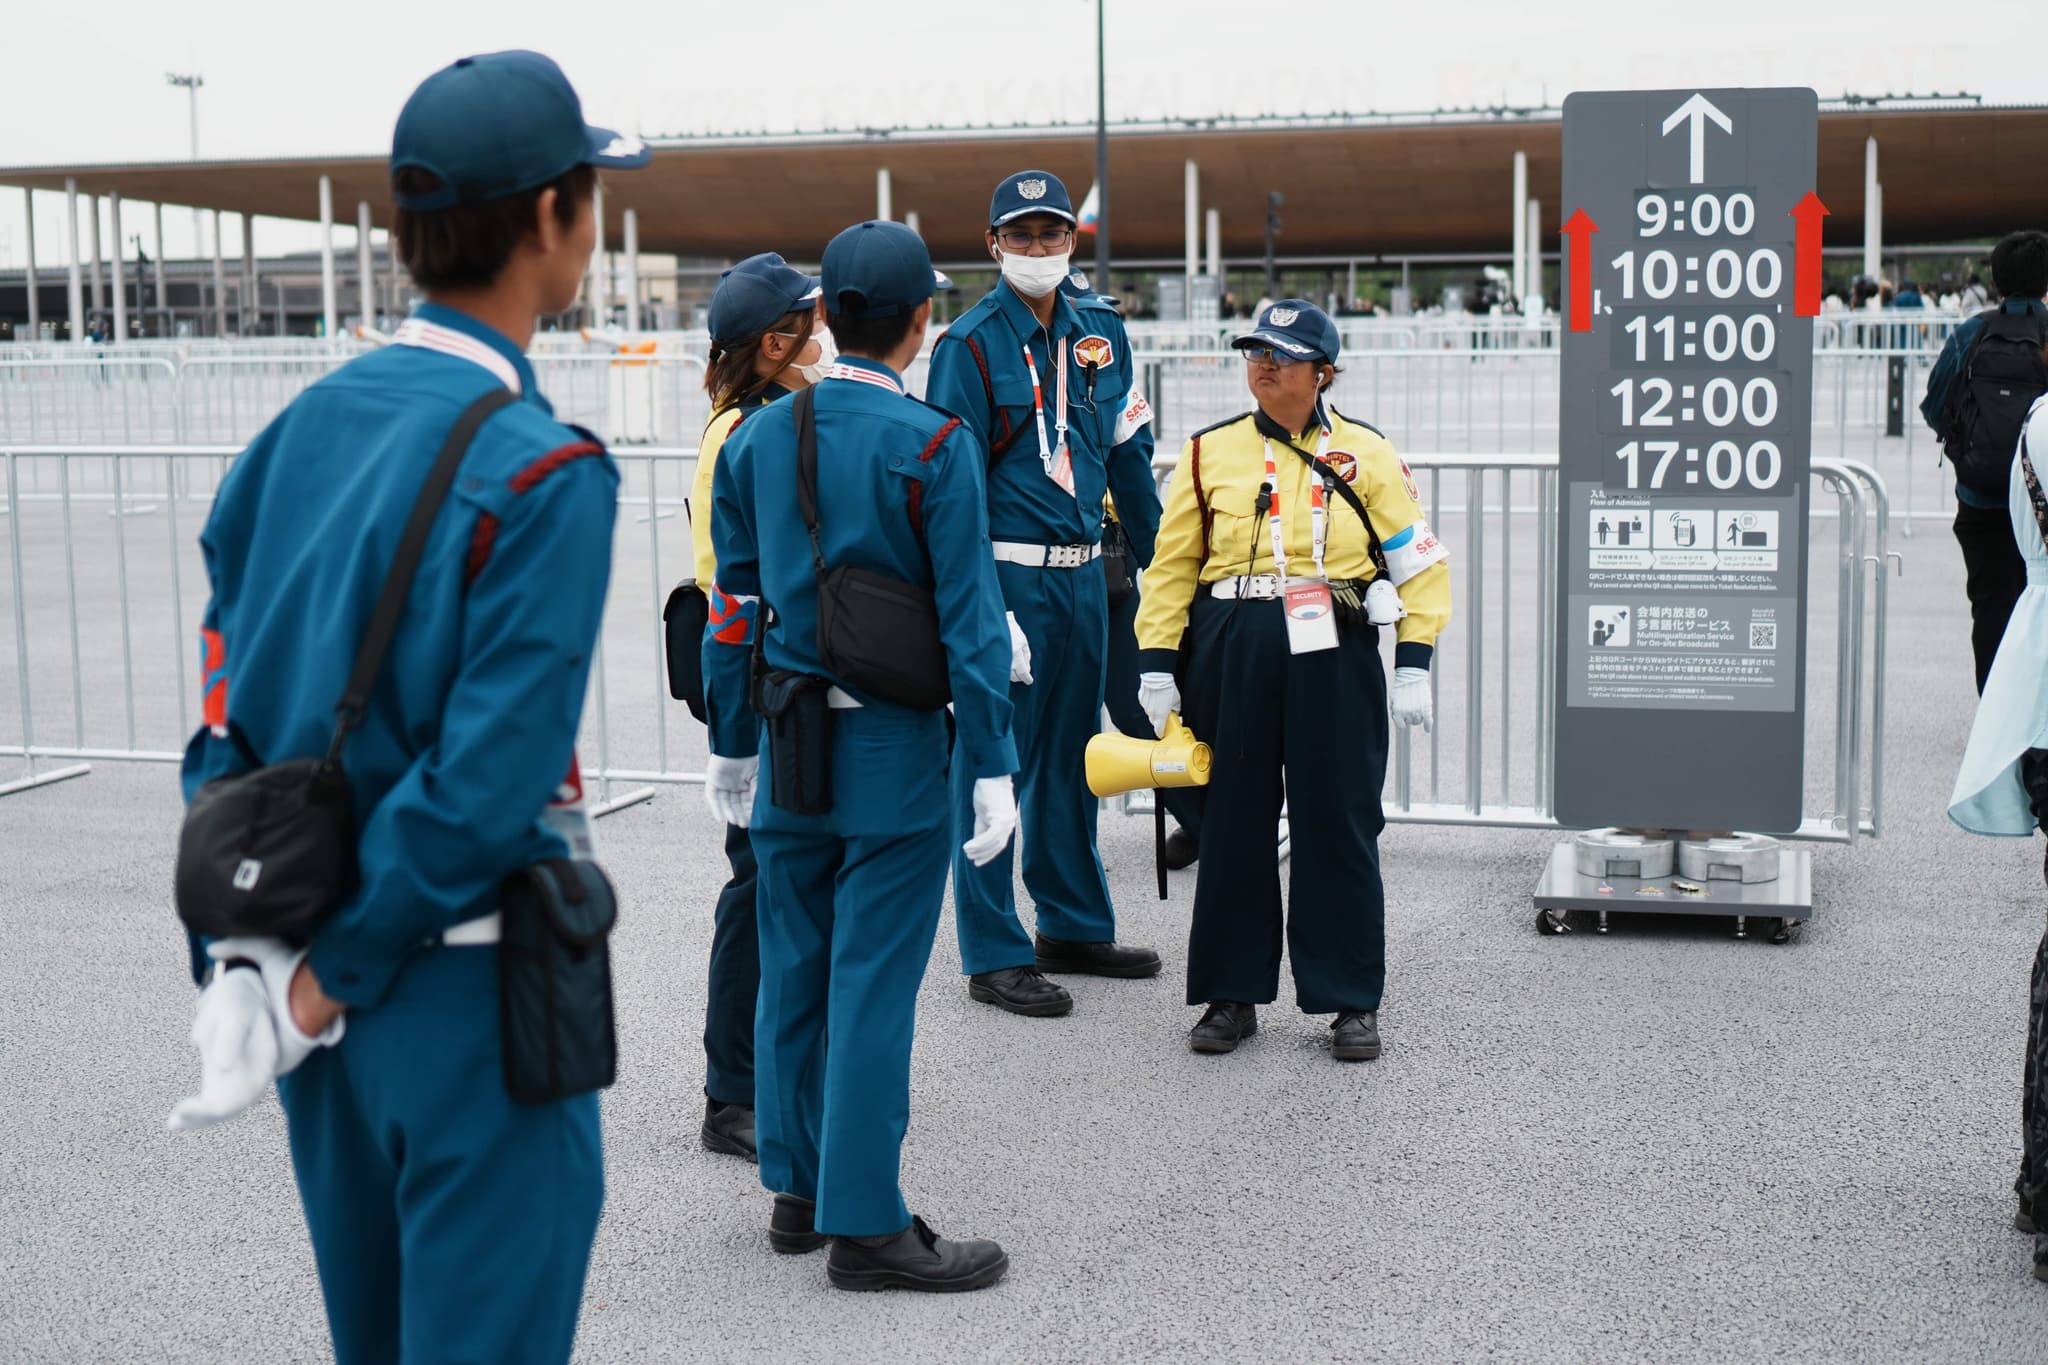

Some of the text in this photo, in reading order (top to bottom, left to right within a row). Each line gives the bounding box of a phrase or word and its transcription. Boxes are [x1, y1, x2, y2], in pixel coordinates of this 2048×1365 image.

[1638, 194, 1754, 236] 9:00
[1612, 249, 1781, 299] 10:00
[1625, 314, 1775, 361] 11:00
[1611, 378, 1777, 426] 12:00
[1616, 441, 1781, 489] 17:00
[1293, 591, 1322, 600] SECURITY
[1637, 606, 1708, 618] 会場内放送の
[1637, 619, 1731, 631] 多言語化サービス
[1637, 632, 1706, 643] Multilingualization
[1649, 640, 1676, 648] On-site
